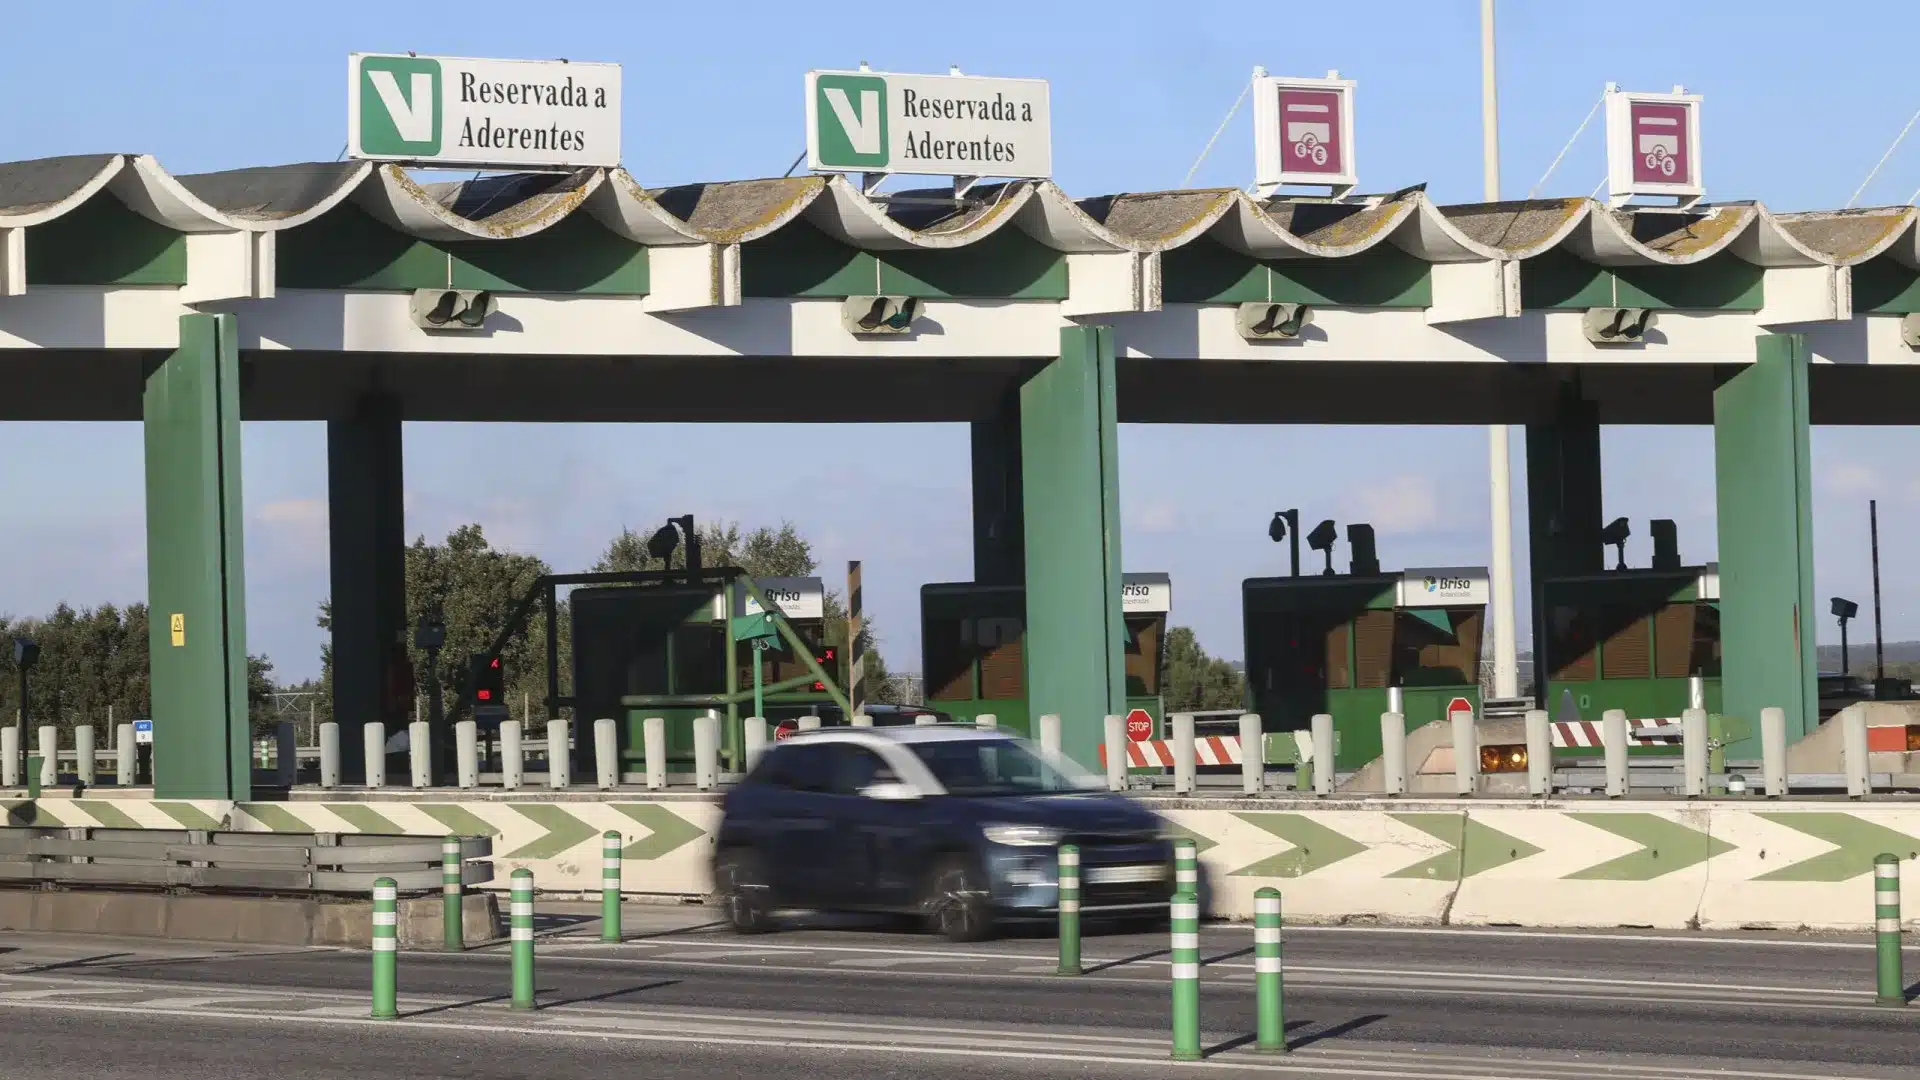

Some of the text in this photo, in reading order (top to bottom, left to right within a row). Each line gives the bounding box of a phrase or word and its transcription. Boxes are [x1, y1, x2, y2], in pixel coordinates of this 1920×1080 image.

[460, 71, 607, 109] Reservada a
[903, 88, 1033, 123] Reservada a
[458, 116, 585, 152] Aderentes
[903, 130, 1016, 163] Aderentes
[1440, 576, 1471, 590] Brisa
[1128, 721, 1149, 732] STOP
